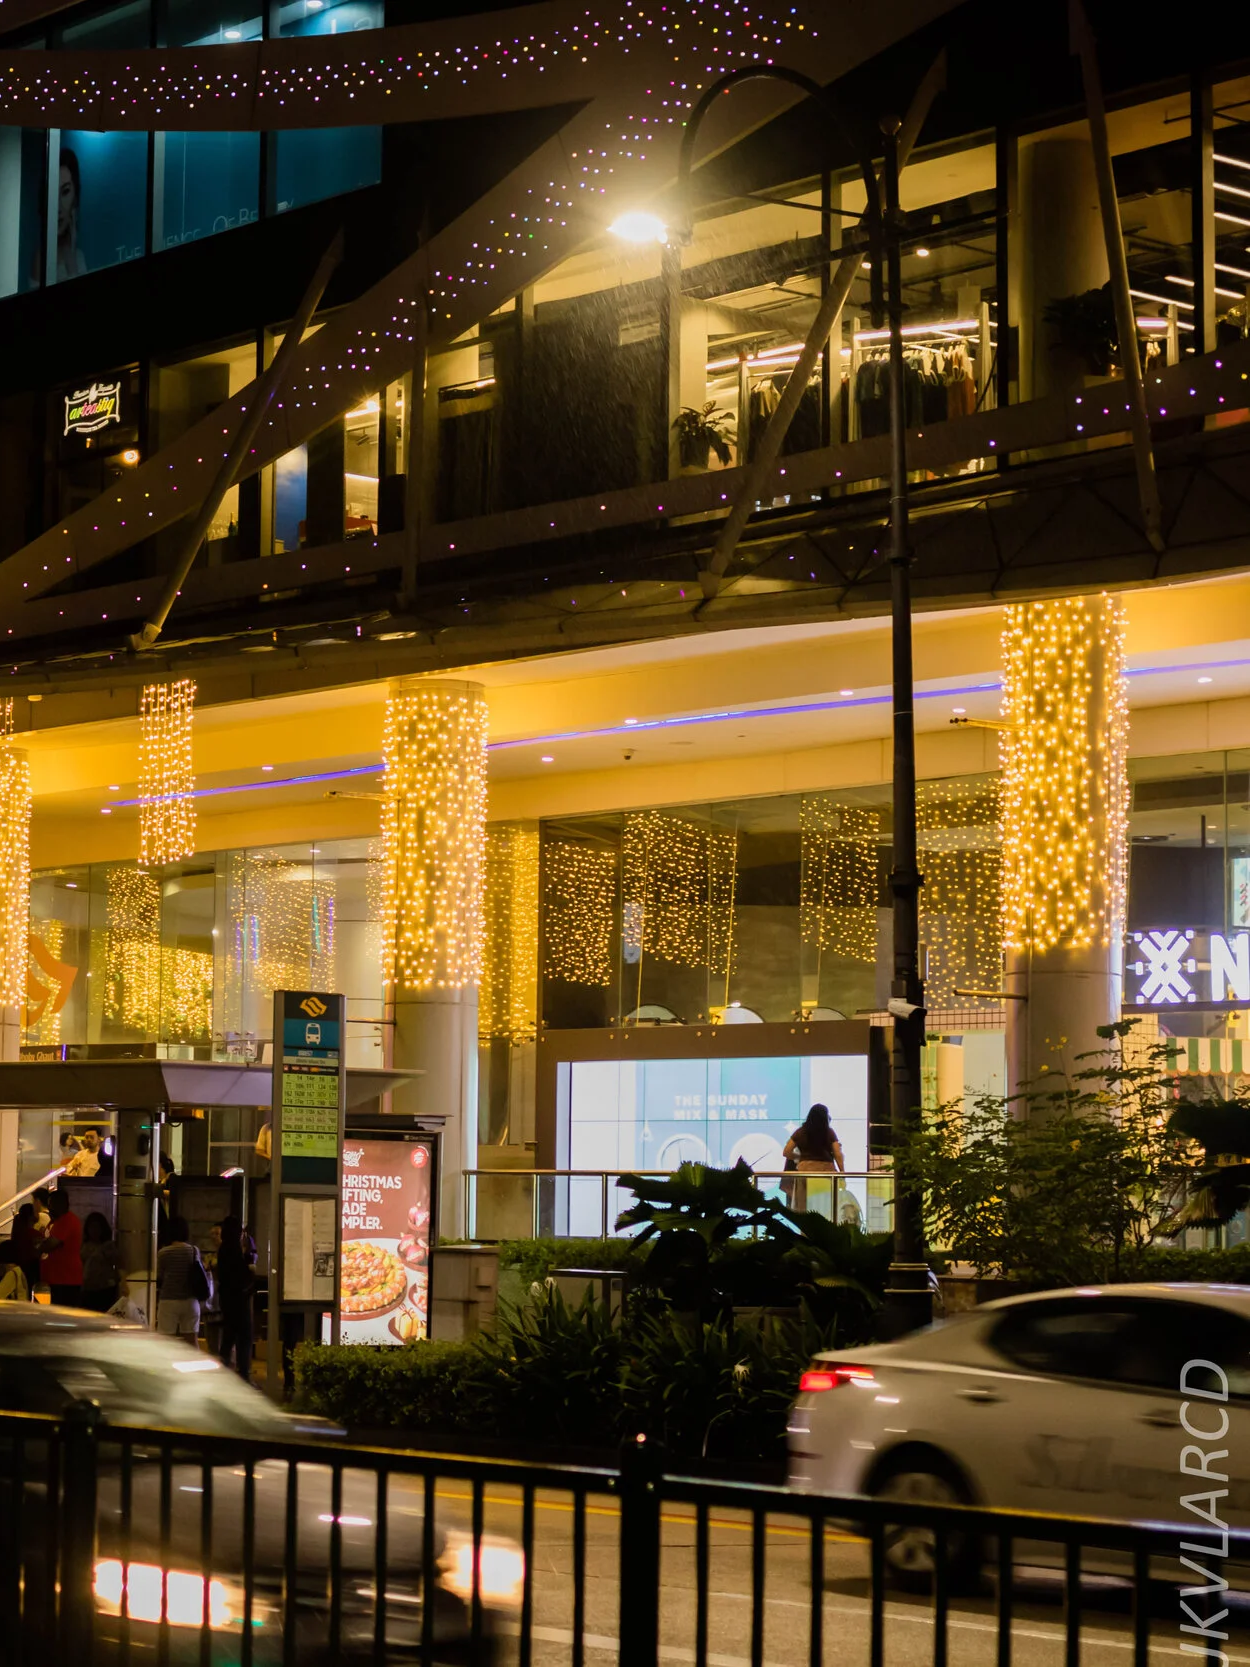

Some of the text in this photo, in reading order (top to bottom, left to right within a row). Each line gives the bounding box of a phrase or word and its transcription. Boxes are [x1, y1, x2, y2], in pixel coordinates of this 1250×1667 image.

[674, 1094, 768, 1107] THE SUNDAY
[674, 1109, 702, 1121] MIX
[725, 1108, 768, 1120] MASK
[342, 1174, 402, 1189] HRISTMAS
[342, 1188, 384, 1204] IFTING,
[342, 1202, 367, 1215] ADE
[342, 1215, 384, 1230] MPLER.
